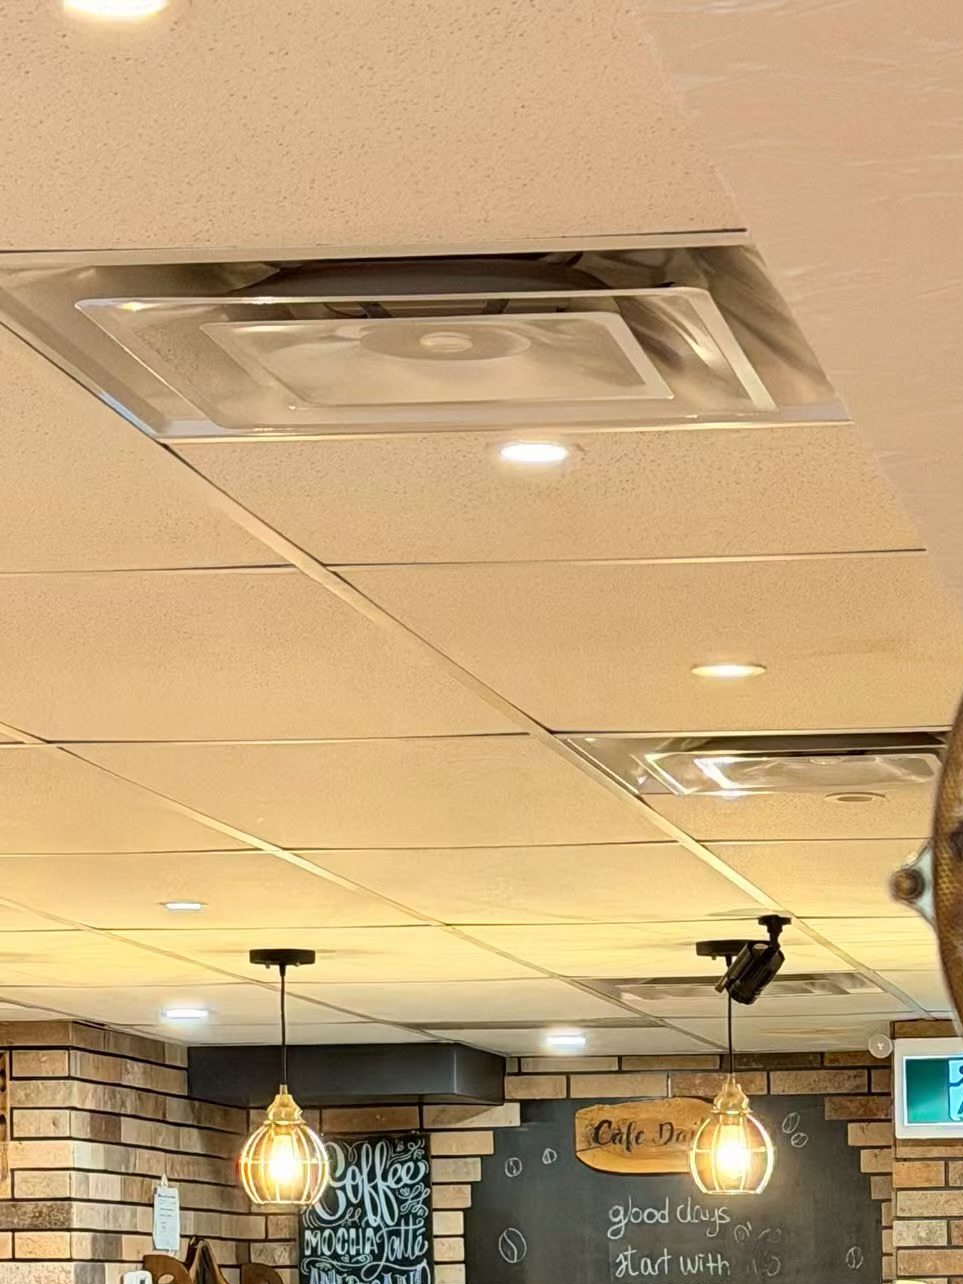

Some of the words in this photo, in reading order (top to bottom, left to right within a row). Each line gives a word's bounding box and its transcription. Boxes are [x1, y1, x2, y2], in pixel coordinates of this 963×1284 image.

[313, 1141, 427, 1226] Coffee
[607, 1195, 669, 1240] good
[676, 1196, 731, 1237] days
[304, 1227, 379, 1257] MOCHA
[615, 1245, 672, 1278] start
[680, 1253, 731, 1276] with
